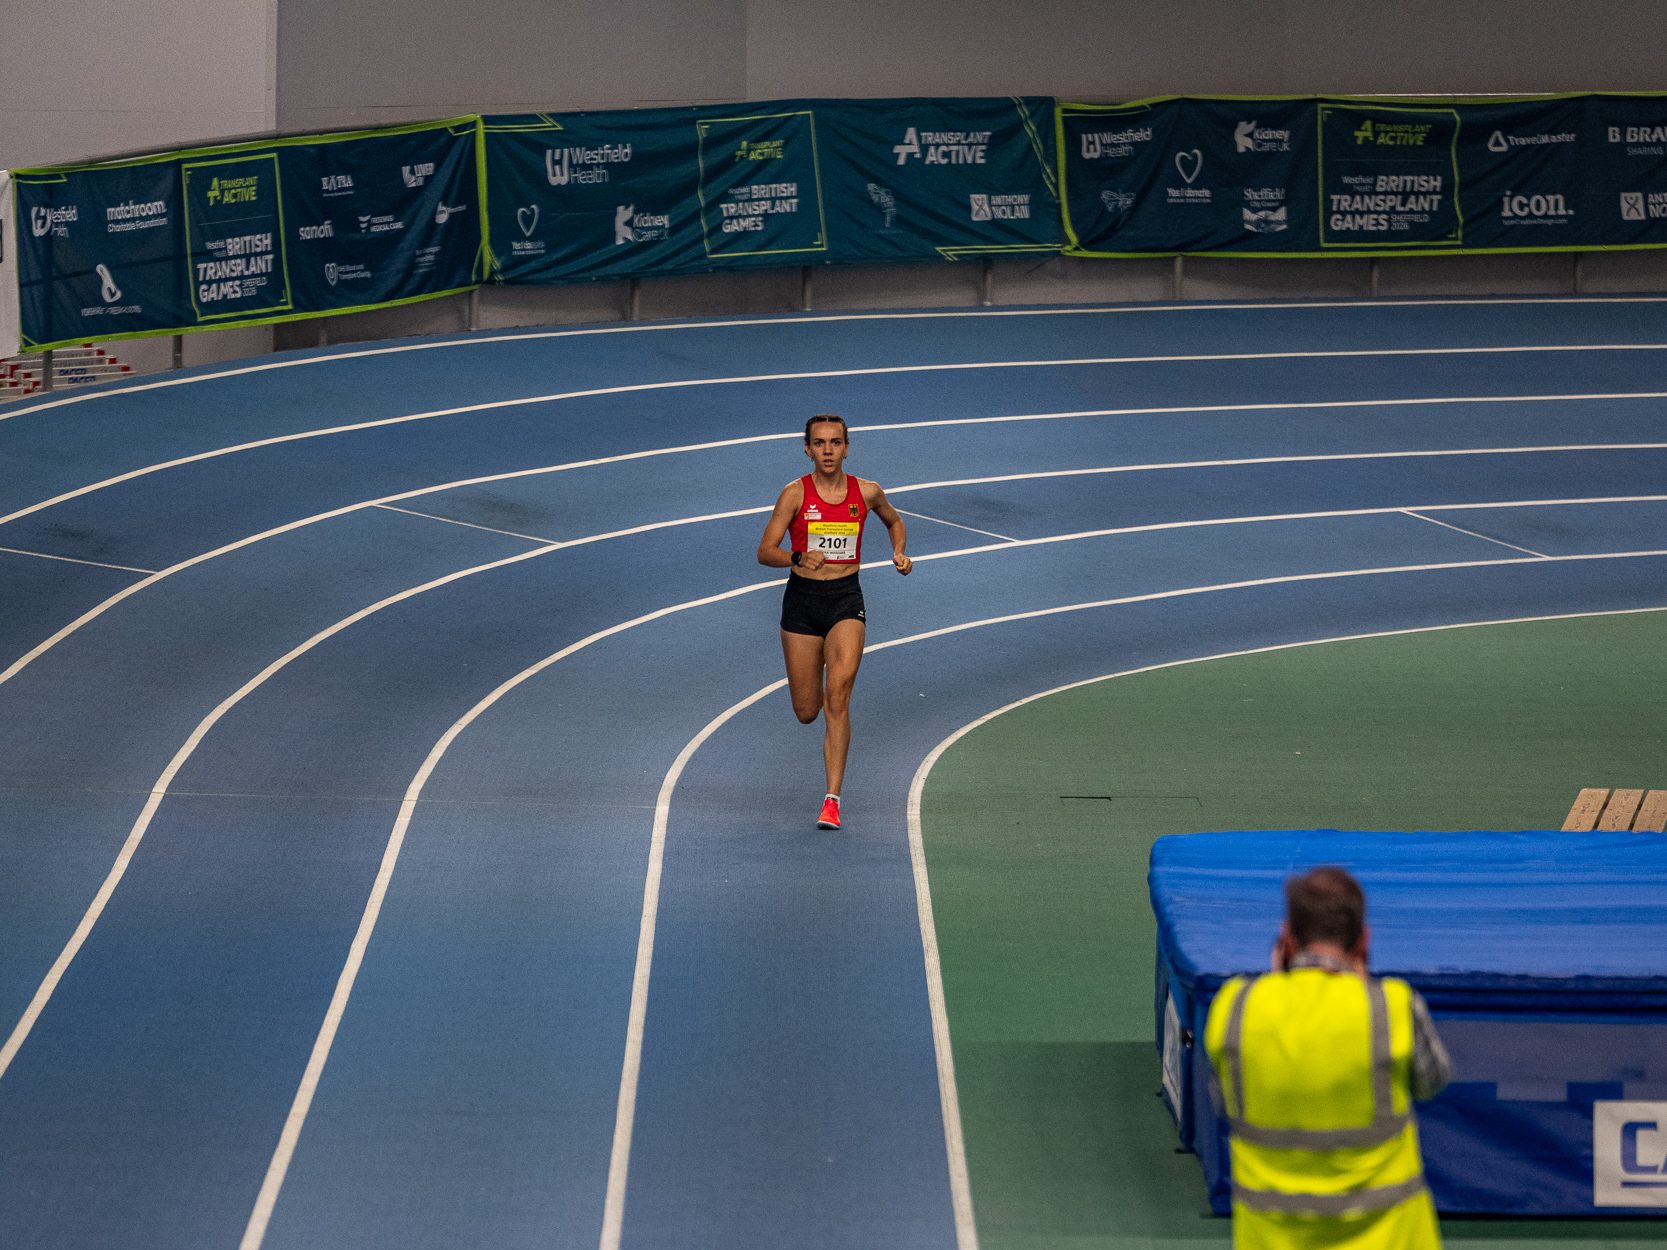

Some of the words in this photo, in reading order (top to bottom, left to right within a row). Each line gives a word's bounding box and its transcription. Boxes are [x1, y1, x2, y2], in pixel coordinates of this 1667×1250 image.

[1100, 128, 1152, 144] Westfield
[1253, 128, 1290, 143] Kidney
[1374, 124, 1432, 133] TRANSPLANT
[1608, 126, 1621, 143] B
[1626, 126, 1667, 143] BRA
[920, 131, 992, 144] TRANSPLANT
[1376, 133, 1427, 145] ACTIVE
[570, 143, 632, 165] Westfield
[749, 148, 783, 160] ACTIVE
[925, 145, 987, 164] ACTIVE
[220, 176, 258, 190] TRANSPLANT
[570, 166, 609, 184] Health
[1375, 175, 1442, 192] BRITISH
[222, 187, 258, 204] ACTIVE
[751, 183, 797, 199] BRITISH
[991, 194, 1031, 205] ANTHONY
[720, 199, 799, 216] TRANSPLANT
[1330, 194, 1442, 211] TRANSPLANT
[632, 212, 671, 229] Kidney
[991, 206, 1031, 219] NOLAN
[299, 220, 334, 240] sanofi
[722, 217, 764, 233] GAMES
[1330, 214, 1389, 231] GAMES
[632, 228, 657, 243] Care
[225, 233, 273, 256] BRITISH
[197, 254, 275, 281] TRANSPLANT
[199, 280, 242, 303] GAMES
[819, 537, 847, 549] 2101
[1620, 1121, 1667, 1175] C
